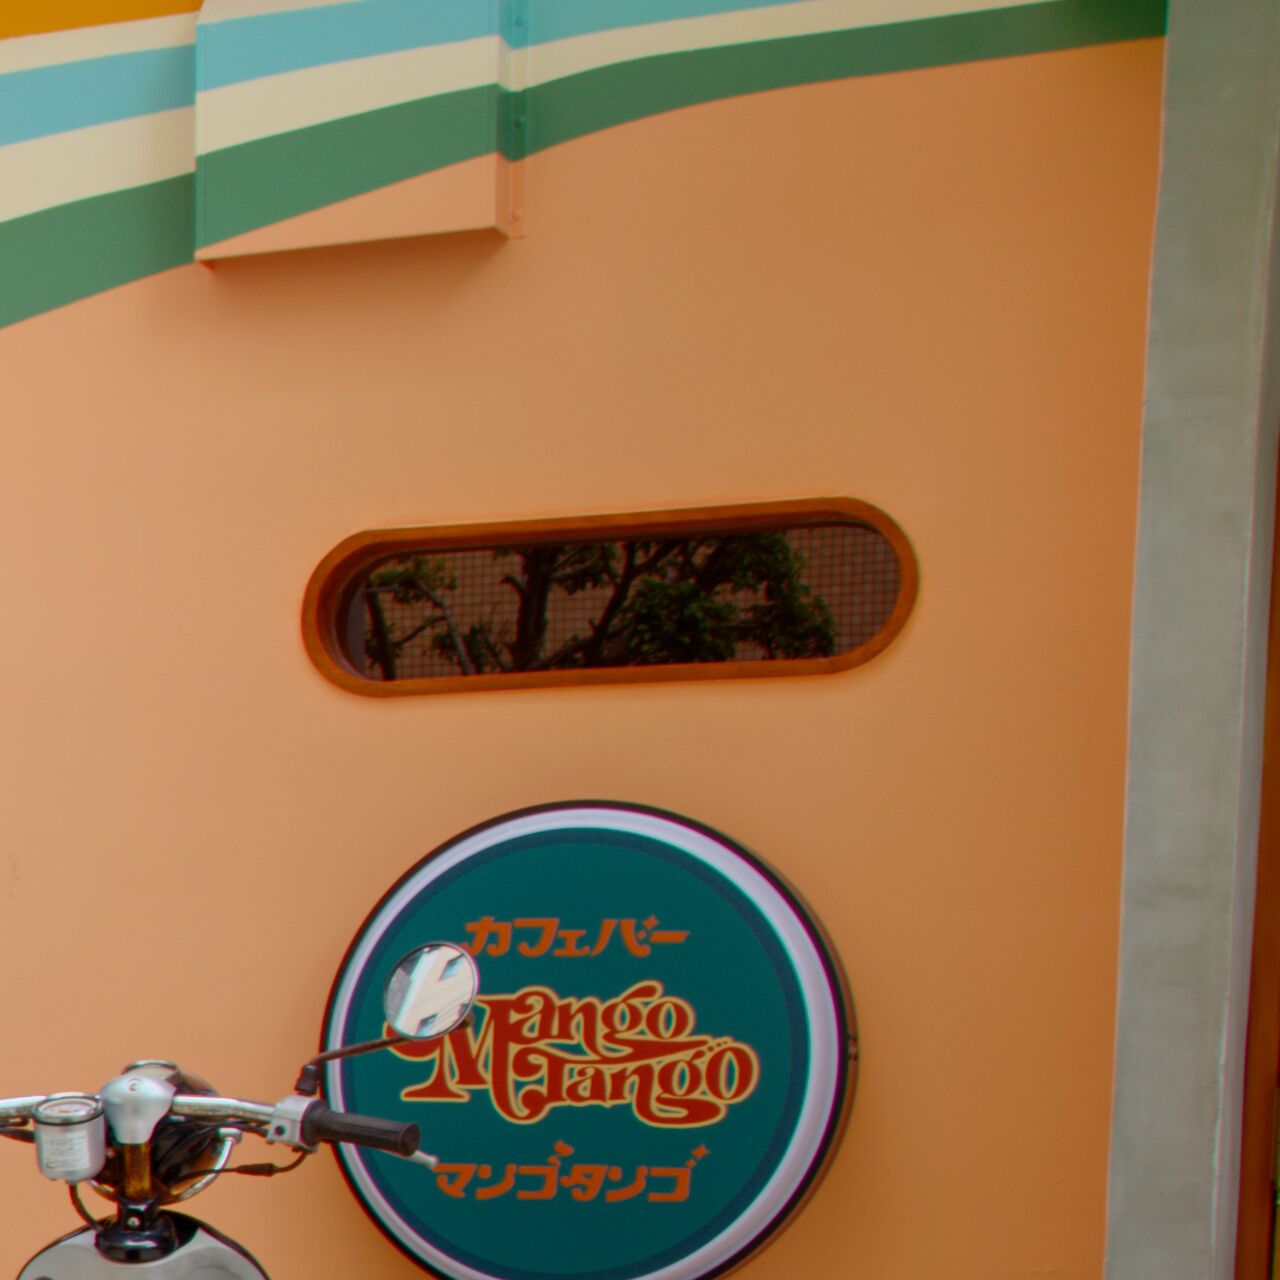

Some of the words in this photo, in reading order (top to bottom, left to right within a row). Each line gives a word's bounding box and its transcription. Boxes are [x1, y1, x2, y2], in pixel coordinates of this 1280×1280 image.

[460, 915, 690, 957] カフェバー
[384, 980, 697, 1124] Mango
[510, 1044, 760, 1128] Tango
